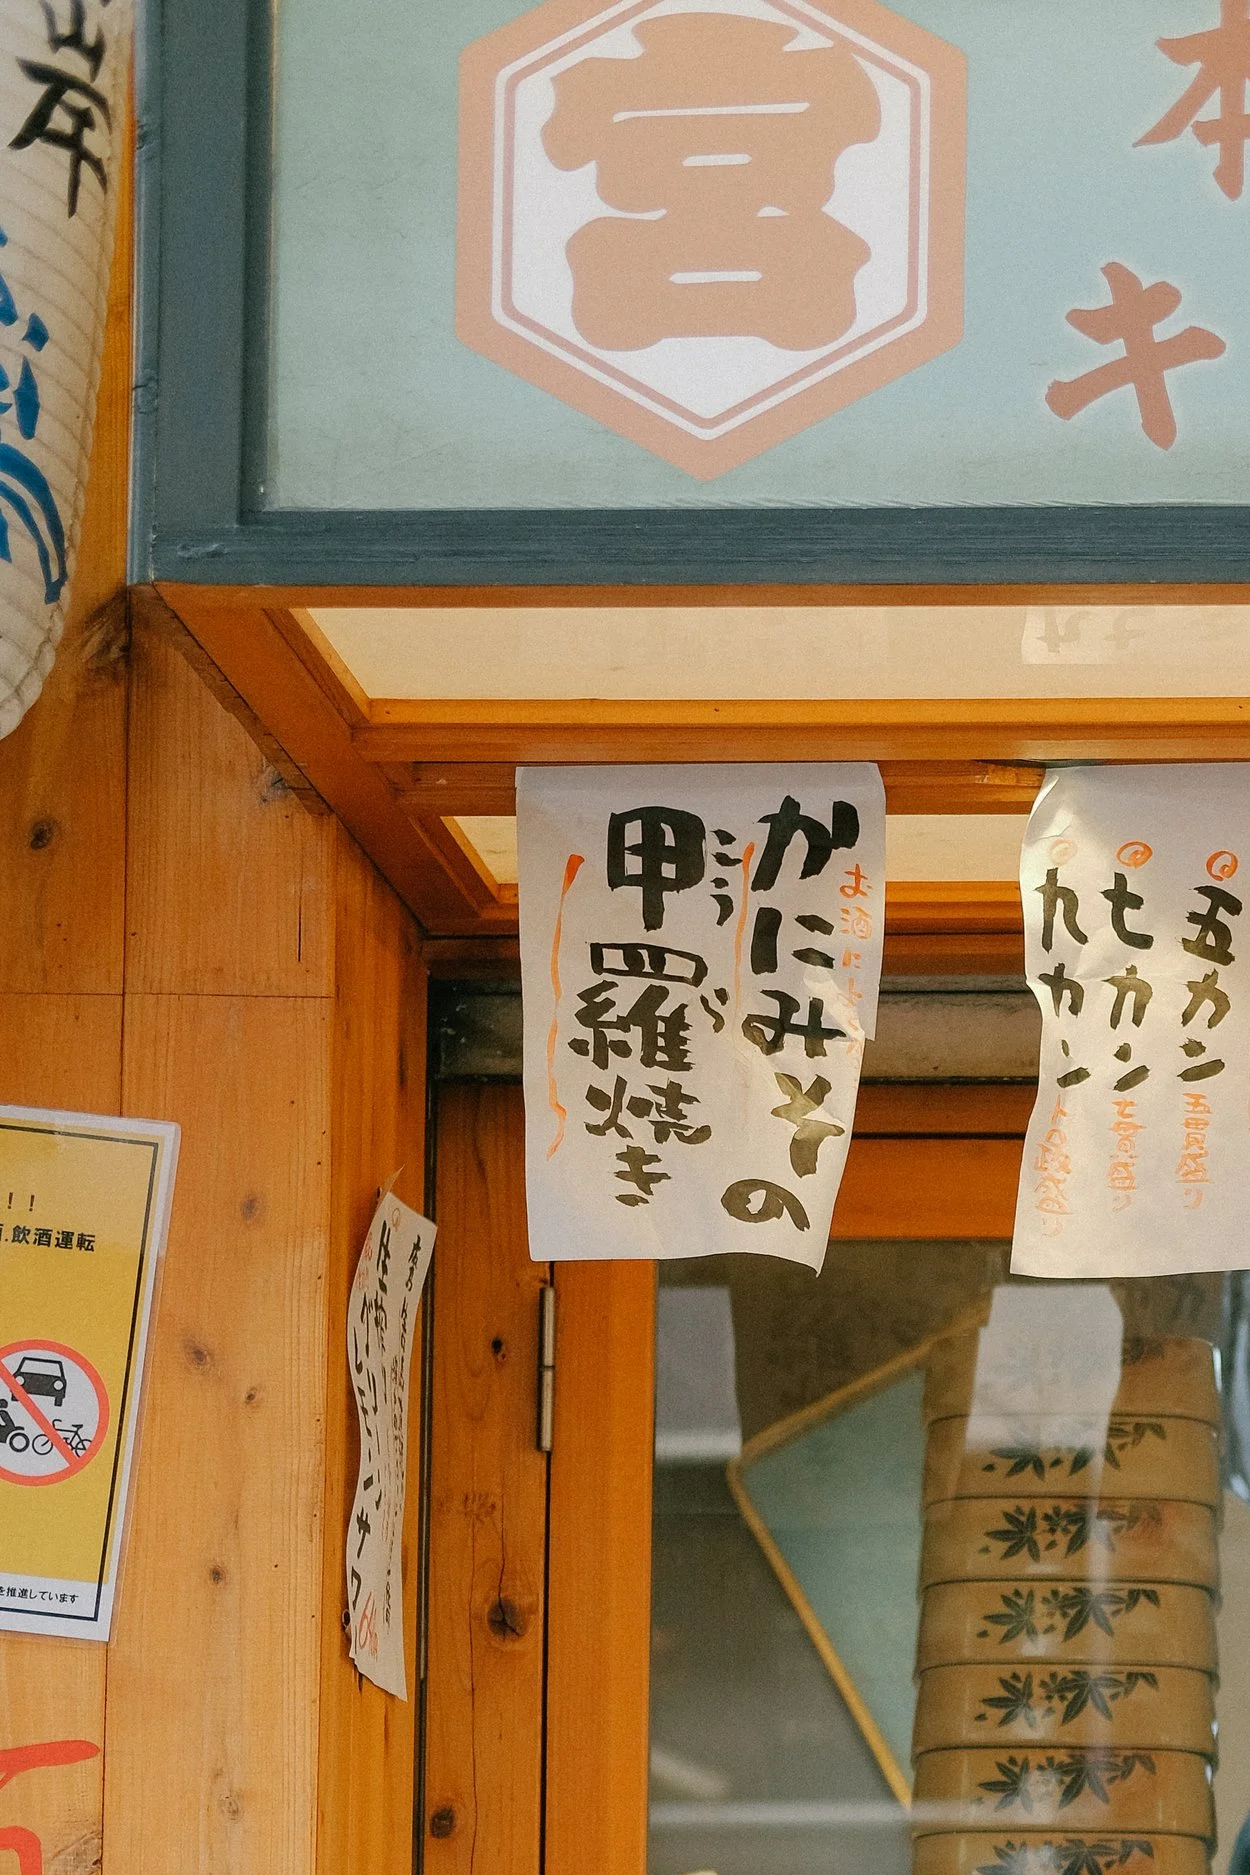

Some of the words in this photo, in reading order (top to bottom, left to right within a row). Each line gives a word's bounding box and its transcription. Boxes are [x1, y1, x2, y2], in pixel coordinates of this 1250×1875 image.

[567, 806, 712, 1208] 甲羅焼き
[721, 795, 859, 1232] かにみその
[1035, 867, 1091, 1089] 九カン
[1100, 872, 1154, 1093] 七カン
[1177, 885, 1244, 1083] 五カン
